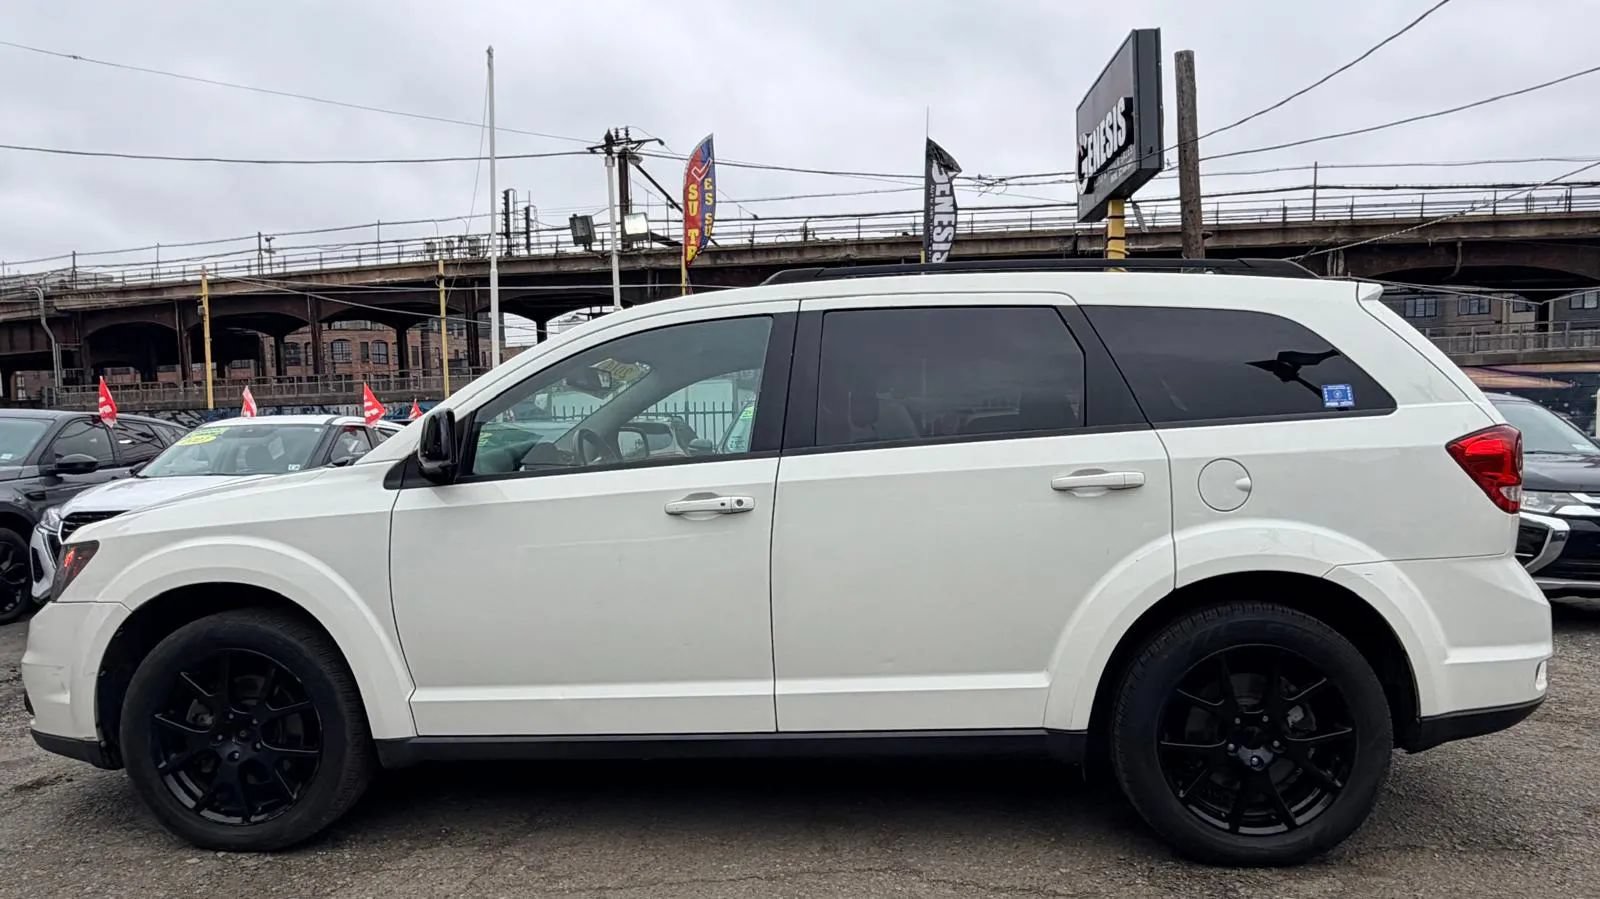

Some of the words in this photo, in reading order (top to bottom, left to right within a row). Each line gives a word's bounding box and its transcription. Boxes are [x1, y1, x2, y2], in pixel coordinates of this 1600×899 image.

[1076, 97, 1126, 195] GENESIS
[688, 184, 699, 217] SU
[704, 212, 713, 237] SU
